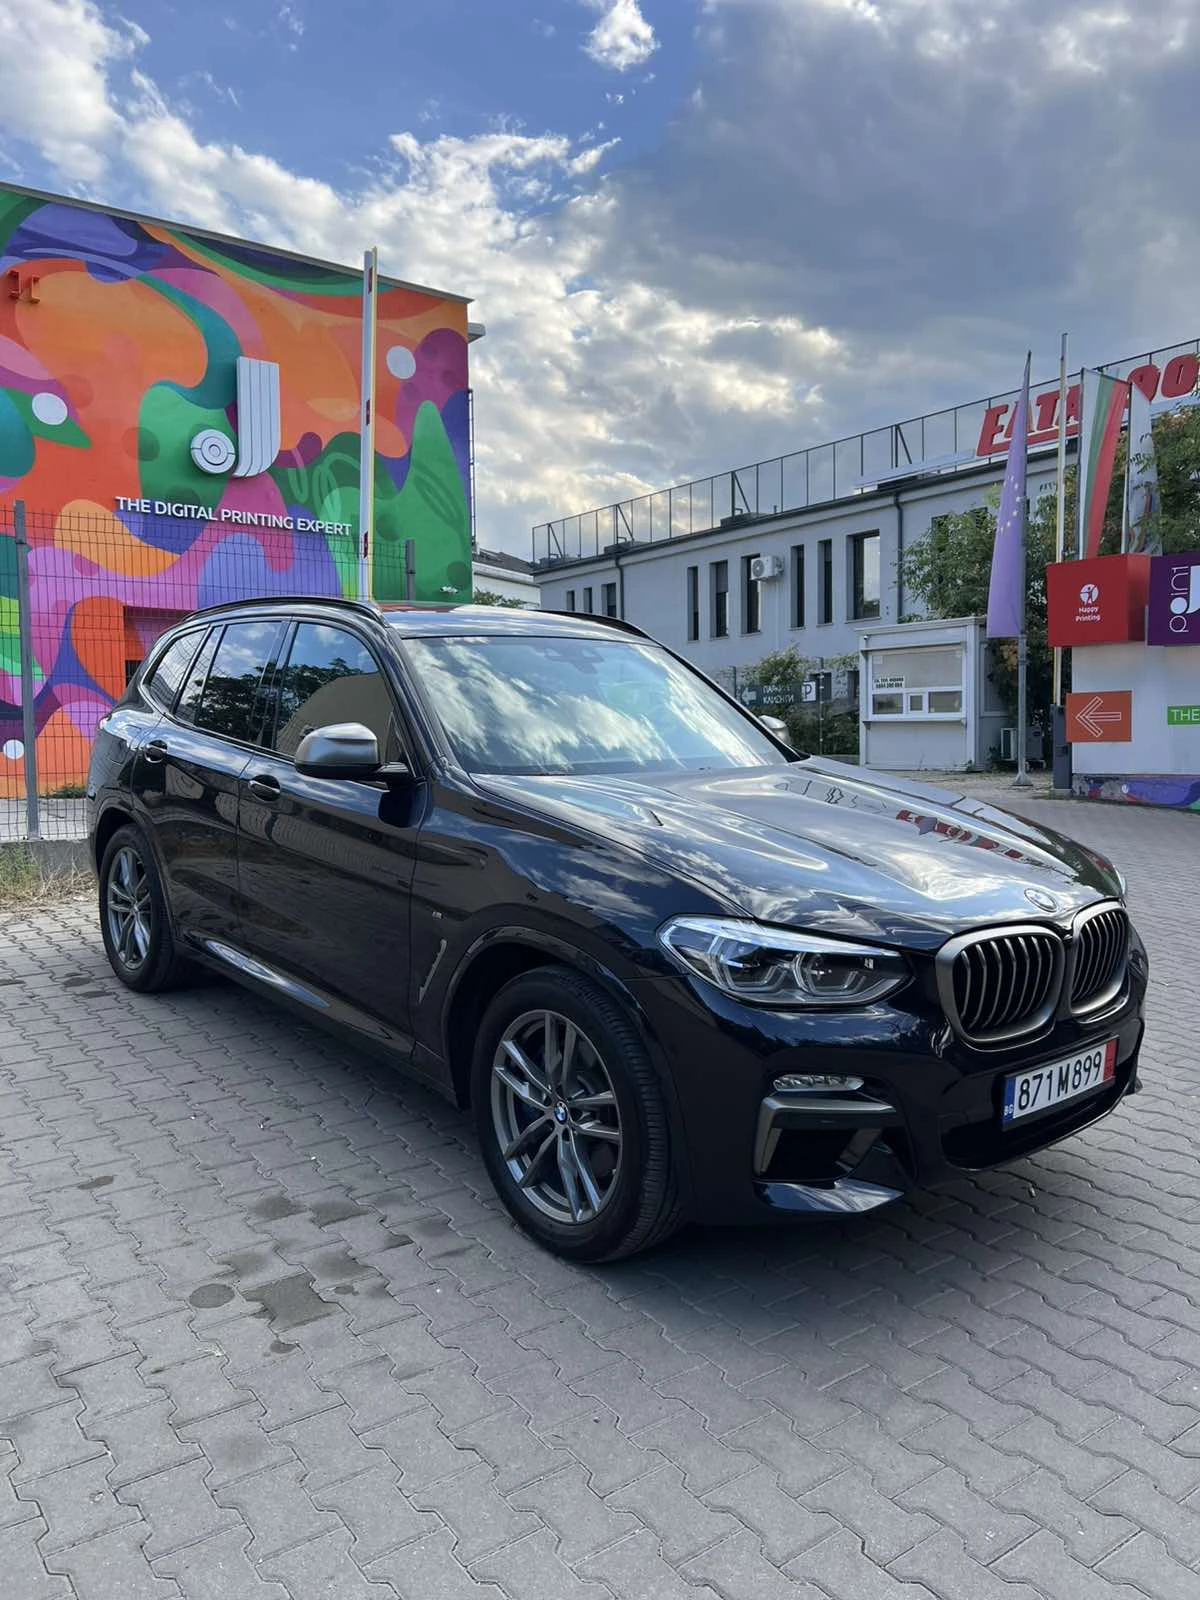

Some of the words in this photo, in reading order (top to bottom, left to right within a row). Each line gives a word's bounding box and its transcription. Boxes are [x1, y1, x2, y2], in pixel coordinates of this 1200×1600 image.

[116, 496, 151, 514] THE
[154, 501, 218, 522] DIGITAL
[221, 509, 294, 531] PRINTING
[296, 517, 352, 537] EXPERT
[1079, 606, 1099, 614] Happy
[1075, 614, 1101, 623] Printing
[1171, 708, 1200, 721] THE
[1018, 1051, 1102, 1111] 871M899
